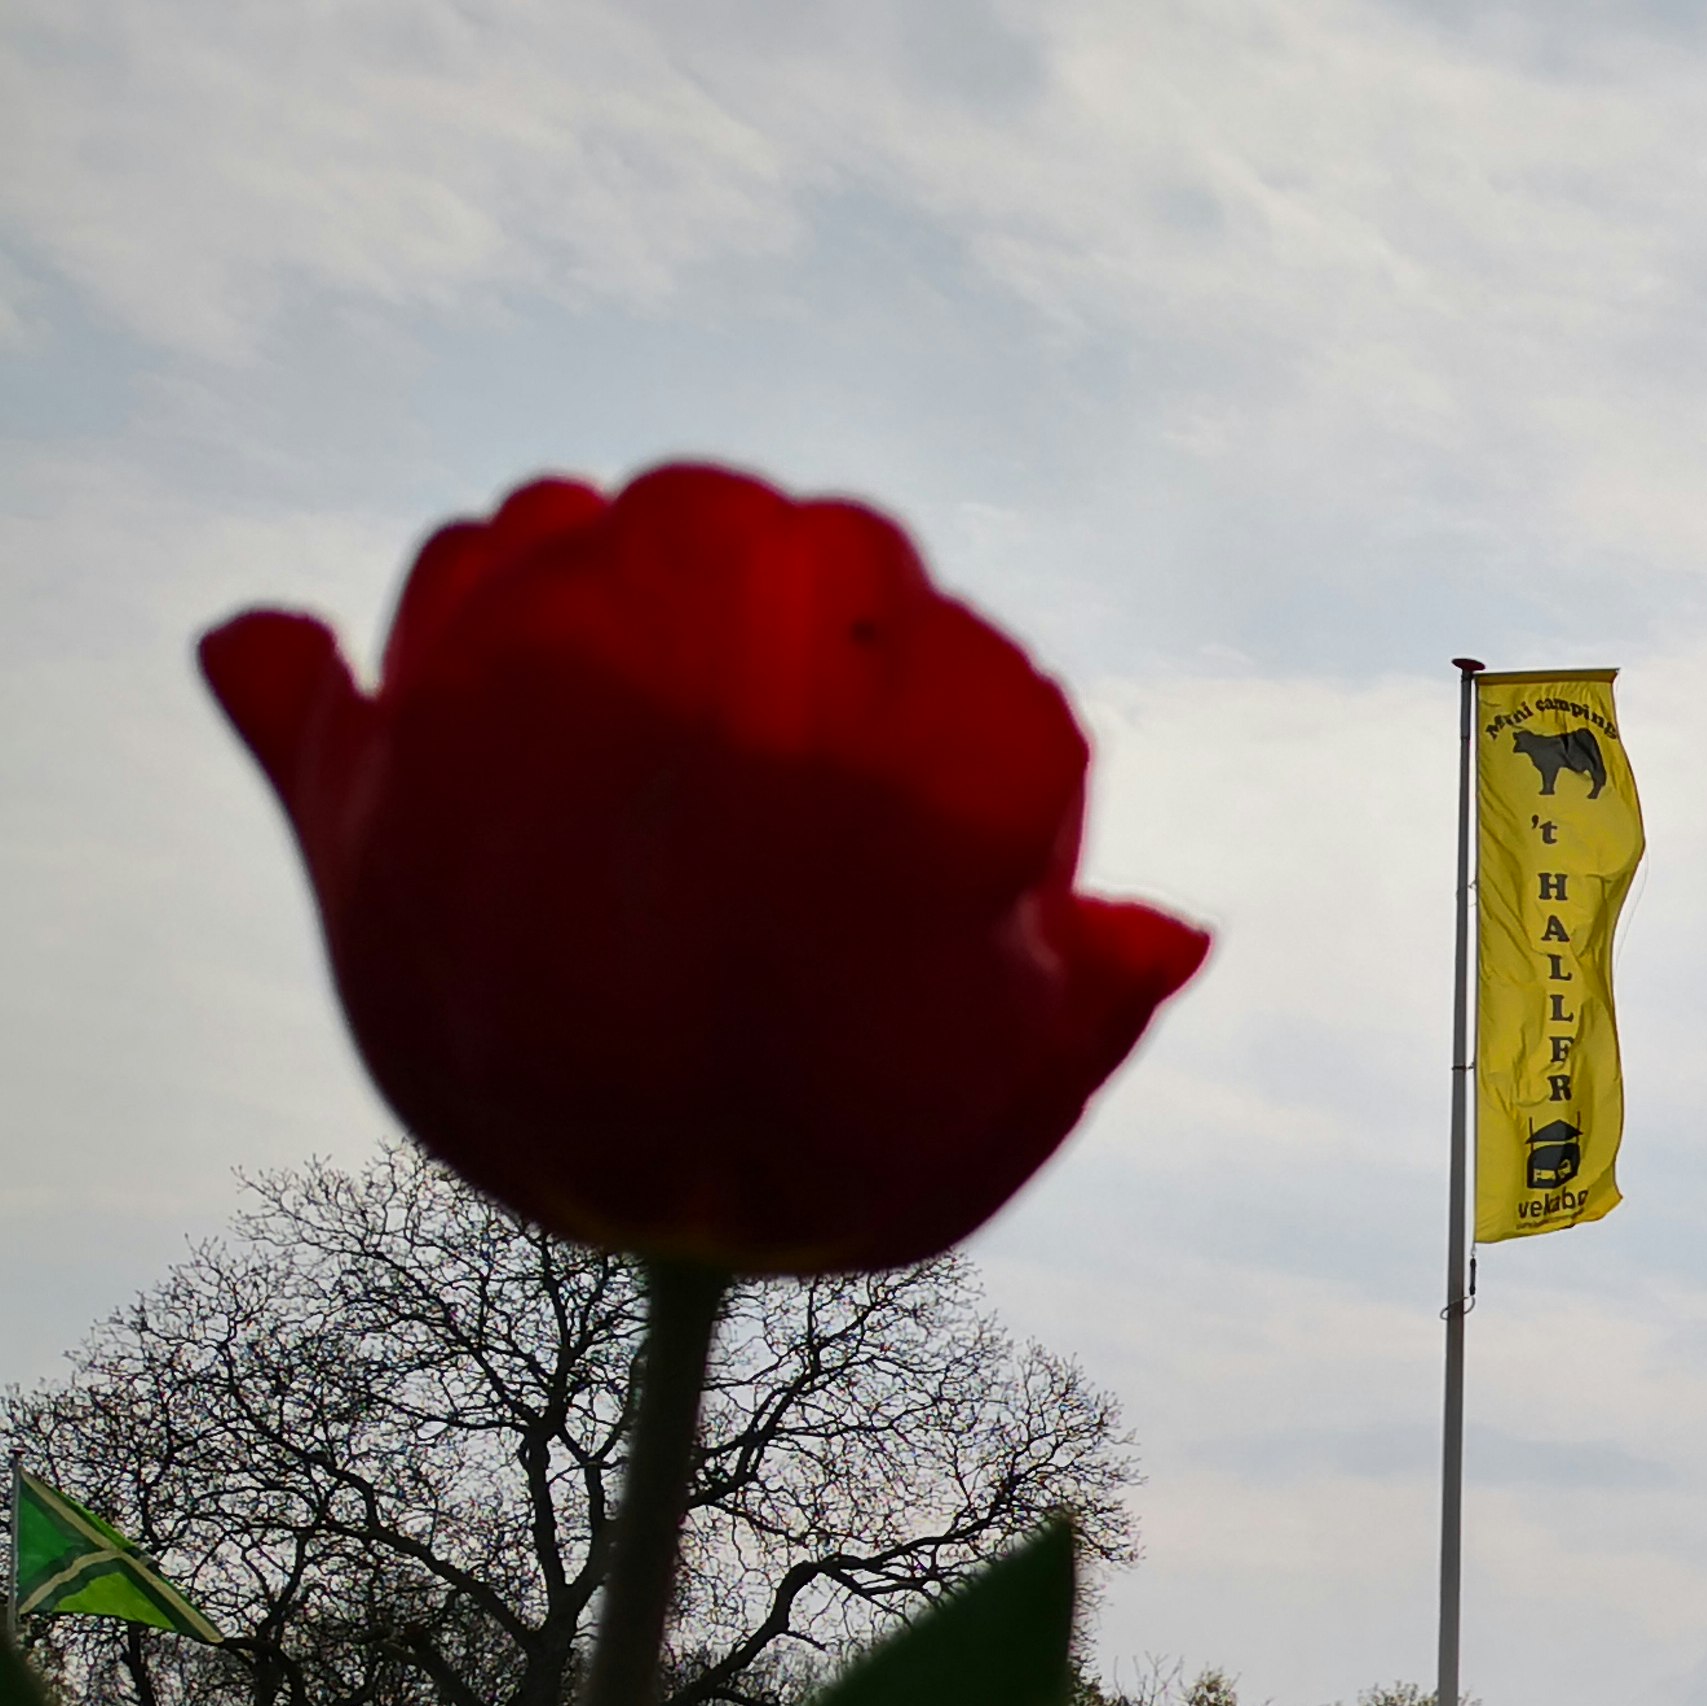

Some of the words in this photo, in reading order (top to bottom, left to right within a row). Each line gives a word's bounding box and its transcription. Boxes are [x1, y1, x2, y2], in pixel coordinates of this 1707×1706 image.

[1486, 701, 1534, 741] Mini
[1535, 697, 1618, 740] camping
[1531, 814, 1558, 845] 't
[1537, 873, 1575, 1101] HALLER
[1518, 1187, 1588, 1219] velabo
